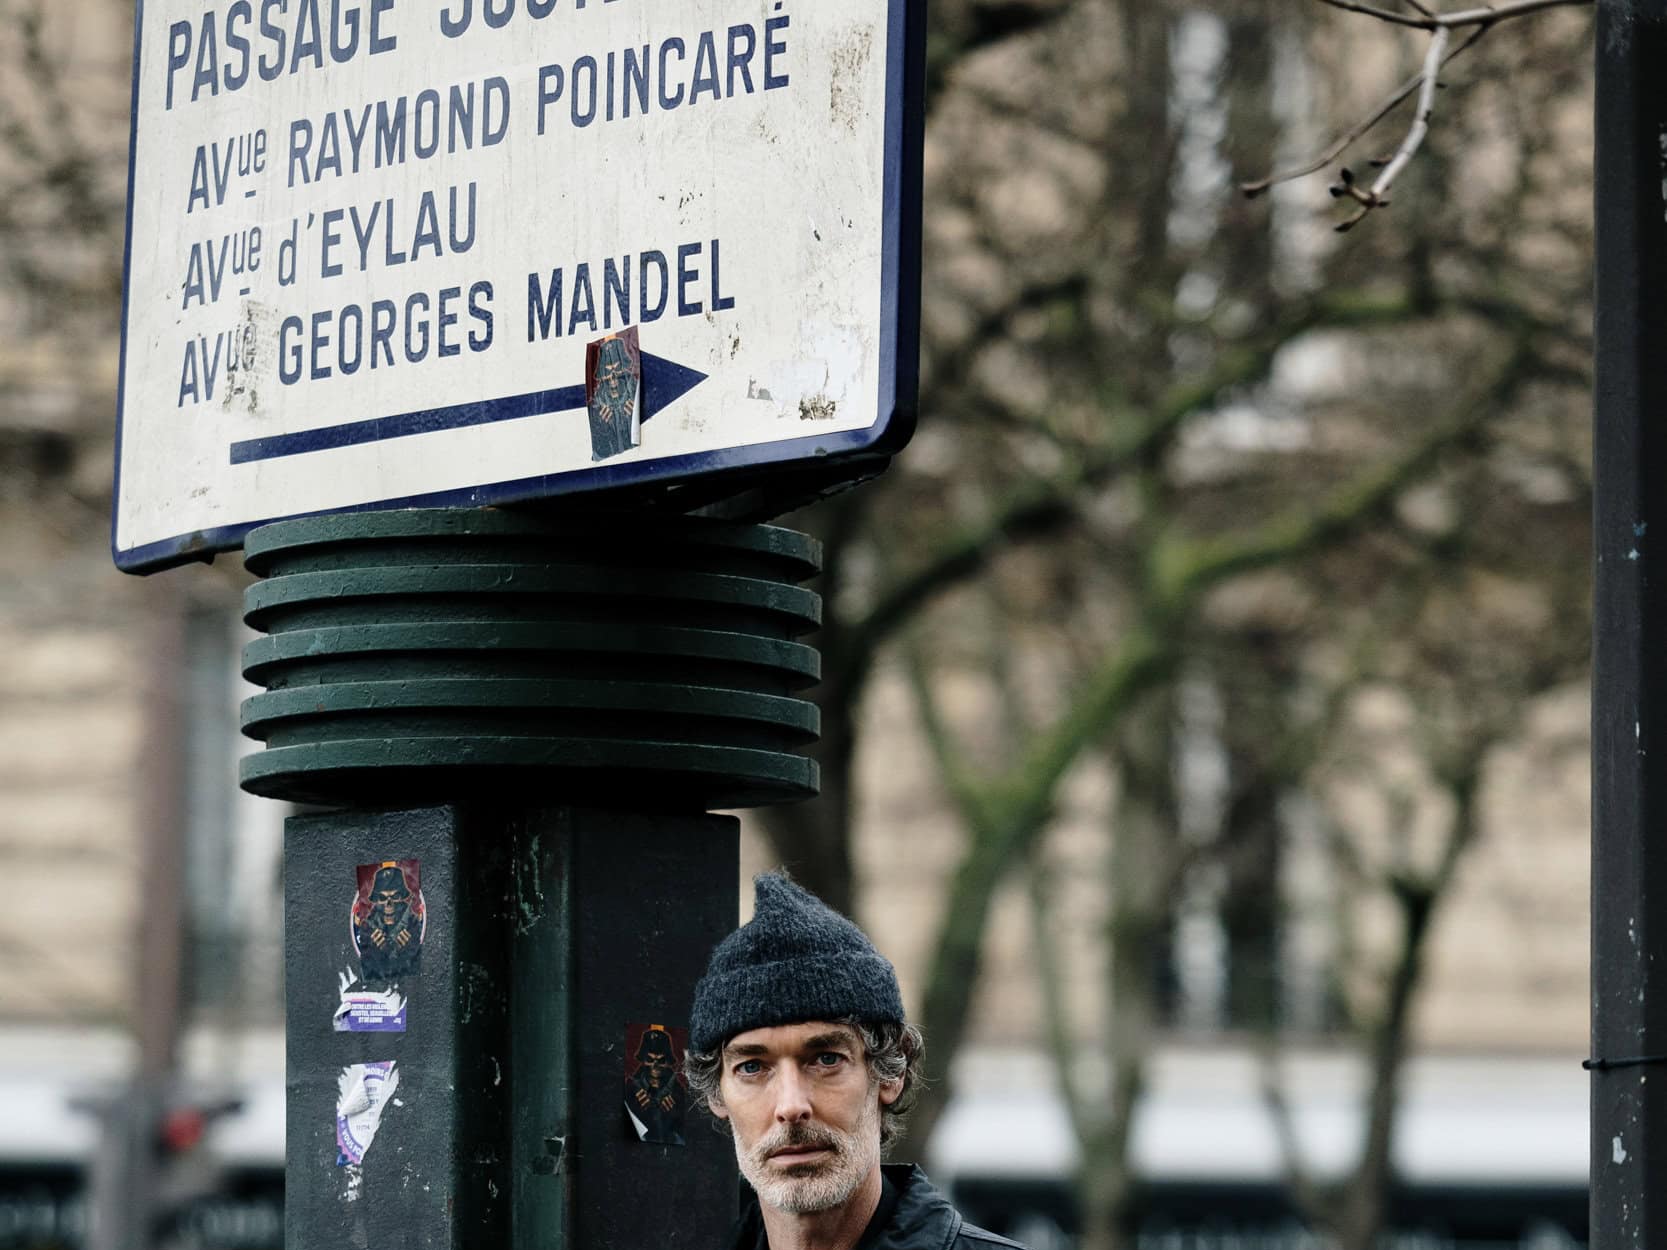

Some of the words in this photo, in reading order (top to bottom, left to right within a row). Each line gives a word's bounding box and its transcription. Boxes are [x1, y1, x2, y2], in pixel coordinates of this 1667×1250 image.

[166, 0, 397, 111] PASSAGE
[287, 76, 511, 188] RAYMOND
[537, 1, 790, 136] POINCARÉ
[278, 182, 477, 286] d'EYLAU
[278, 280, 494, 386] GEORGES
[527, 238, 735, 343] MANDEL
